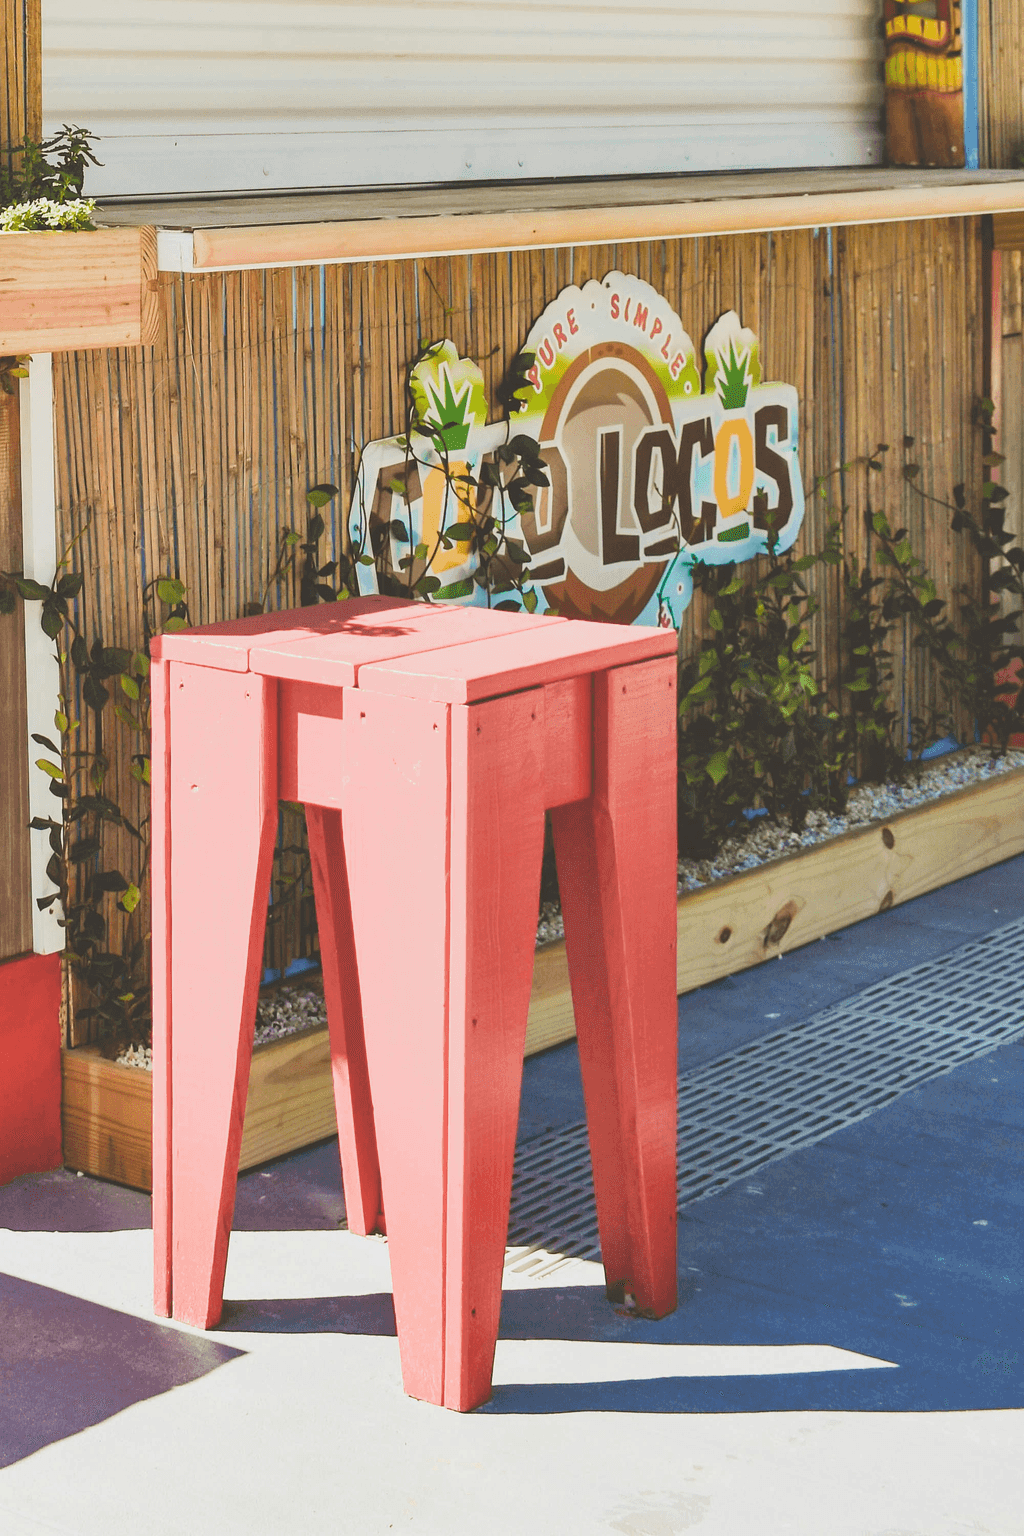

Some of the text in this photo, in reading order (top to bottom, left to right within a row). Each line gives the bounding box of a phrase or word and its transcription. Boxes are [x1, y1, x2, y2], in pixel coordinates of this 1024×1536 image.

[527, 293, 685, 390] PURE SIMPLE
[599, 404, 794, 566] LOCOS
